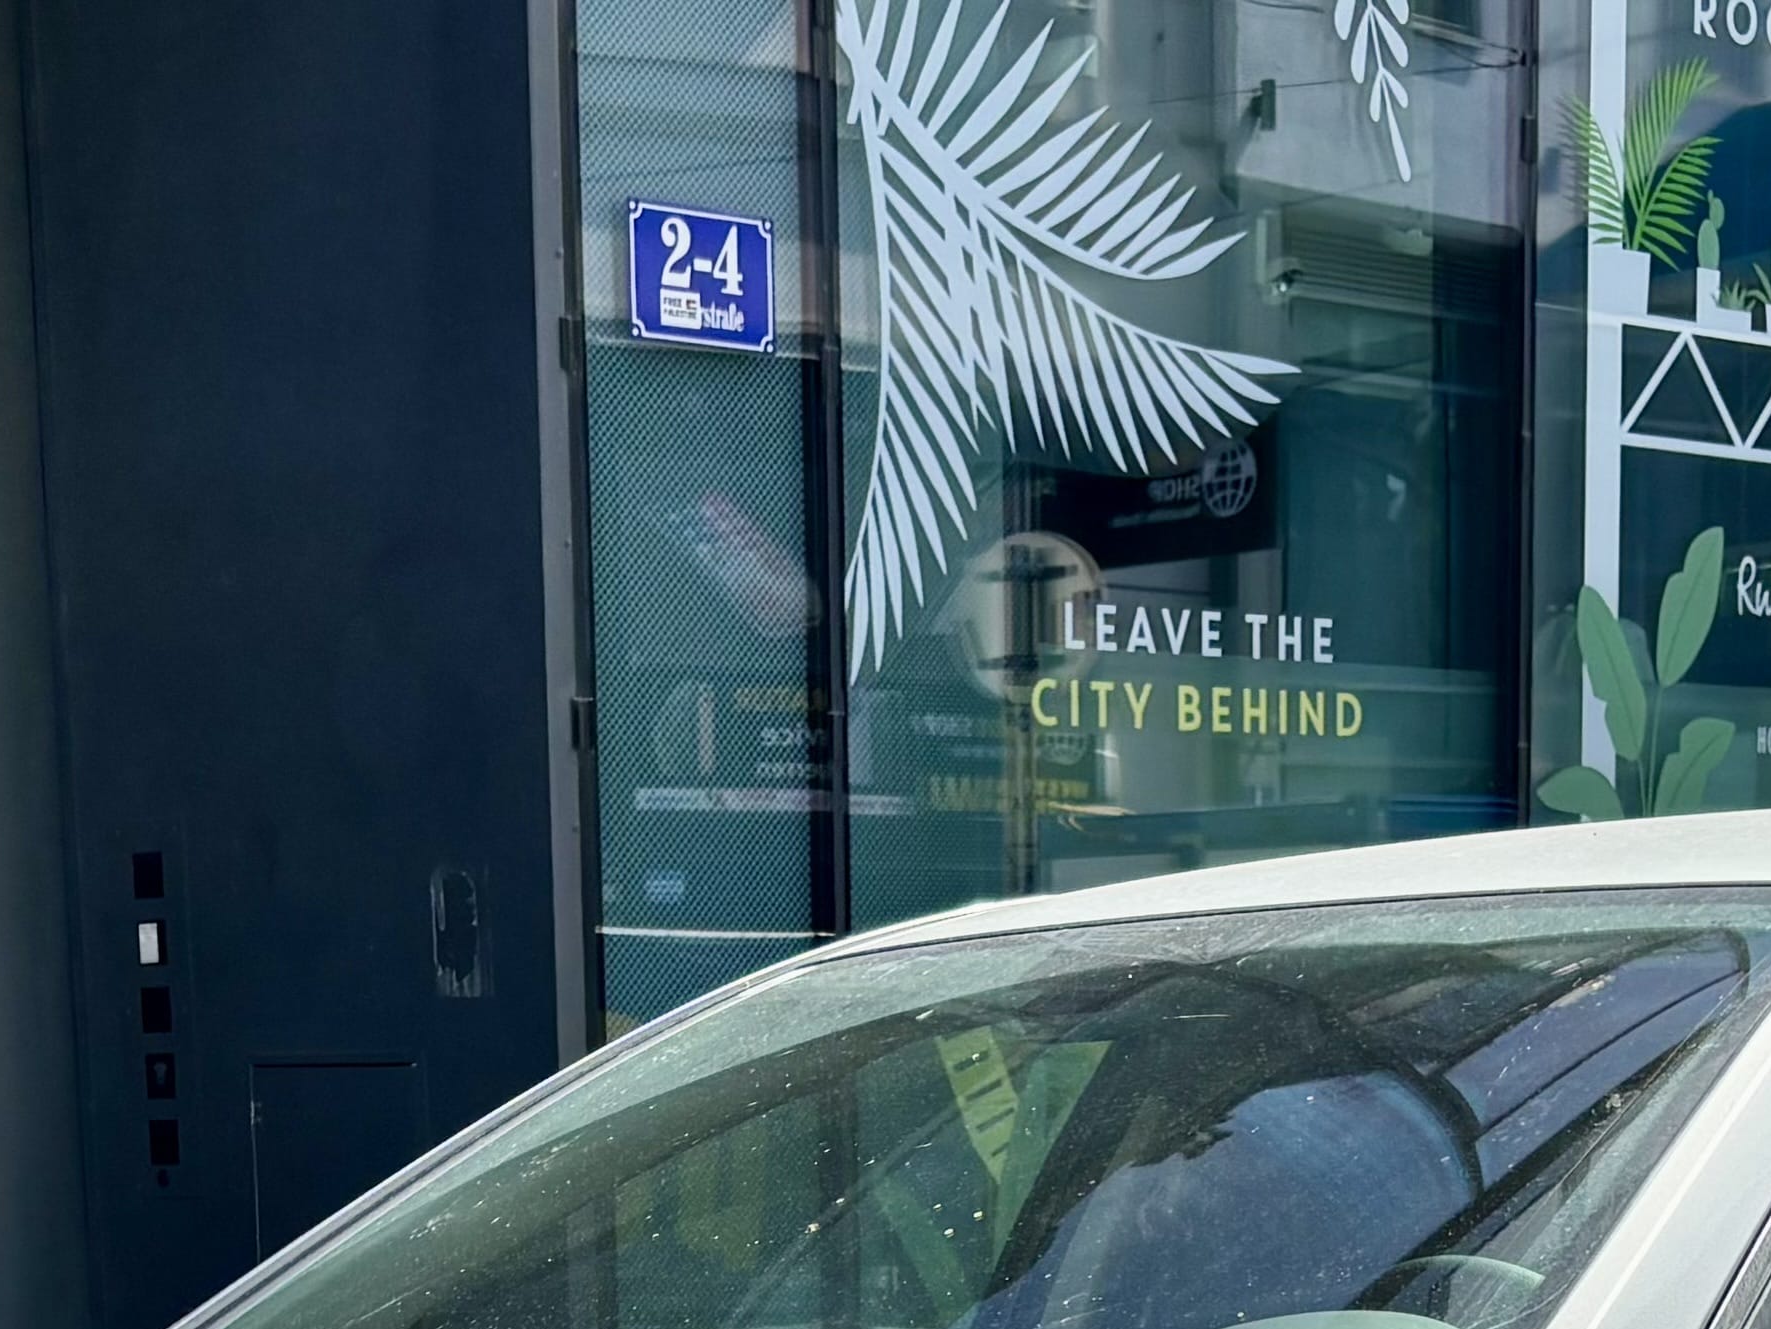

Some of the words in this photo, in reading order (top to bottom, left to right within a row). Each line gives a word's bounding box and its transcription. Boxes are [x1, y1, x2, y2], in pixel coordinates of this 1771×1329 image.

[661, 217, 743, 295] 2-4
[1064, 601, 1223, 657] LEAVE
[1245, 614, 1334, 664] THE
[1031, 678, 1153, 730] CITY
[1178, 685, 1363, 737] BEHIND
